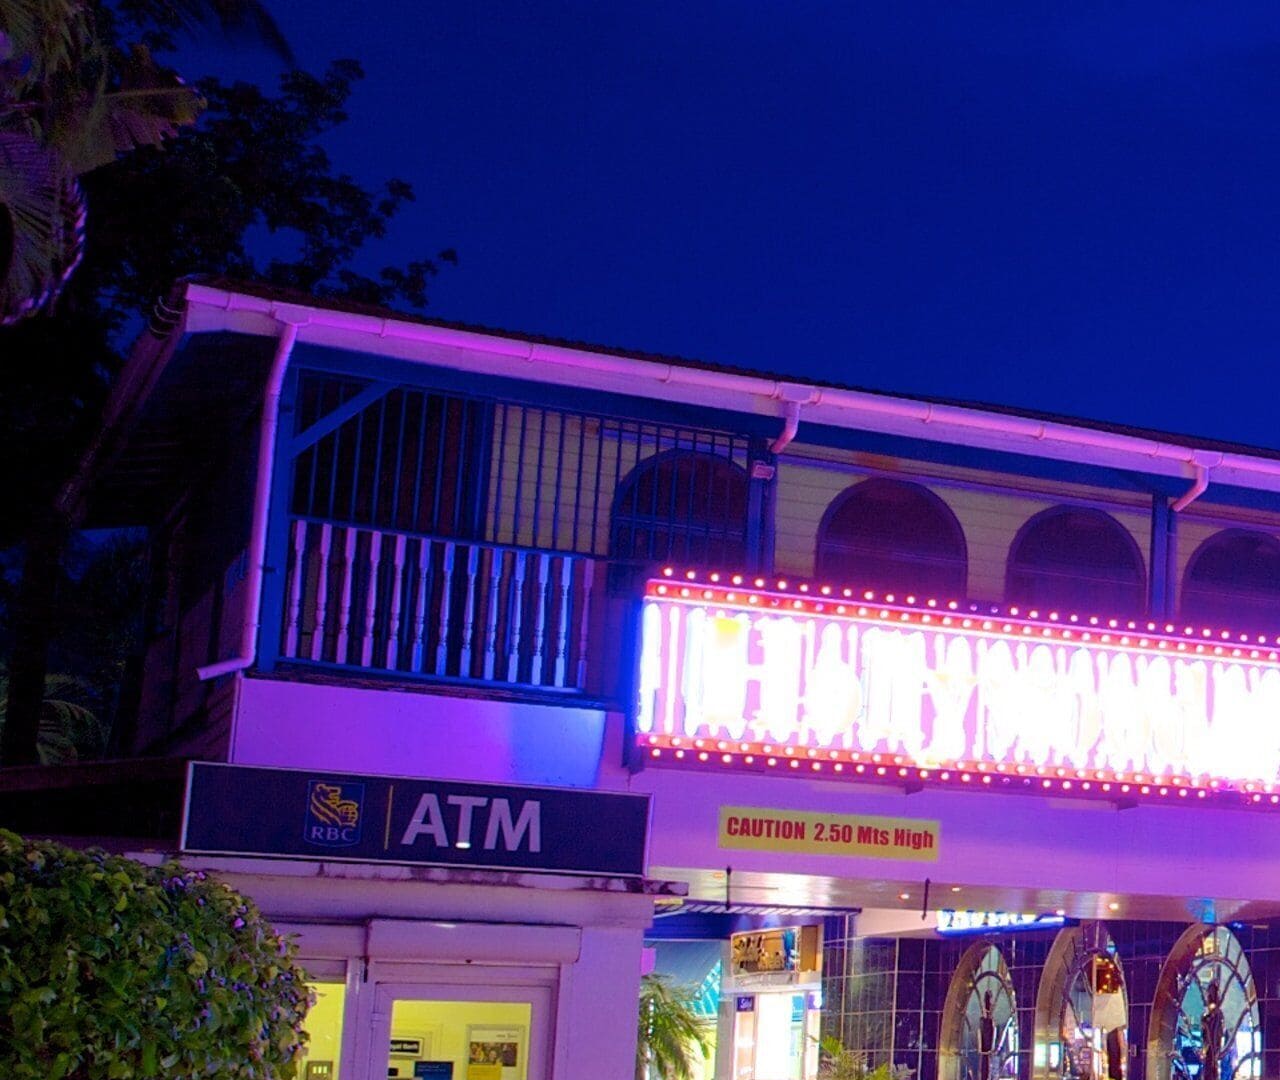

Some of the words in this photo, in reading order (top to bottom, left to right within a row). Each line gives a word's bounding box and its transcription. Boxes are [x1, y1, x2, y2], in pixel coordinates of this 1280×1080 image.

[311, 826, 354, 842] RBC
[401, 793, 541, 853] ATM
[726, 816, 806, 841] CAUTION
[813, 822, 853, 844] 2.50
[857, 826, 889, 846] Mts
[893, 828, 934, 850] High
